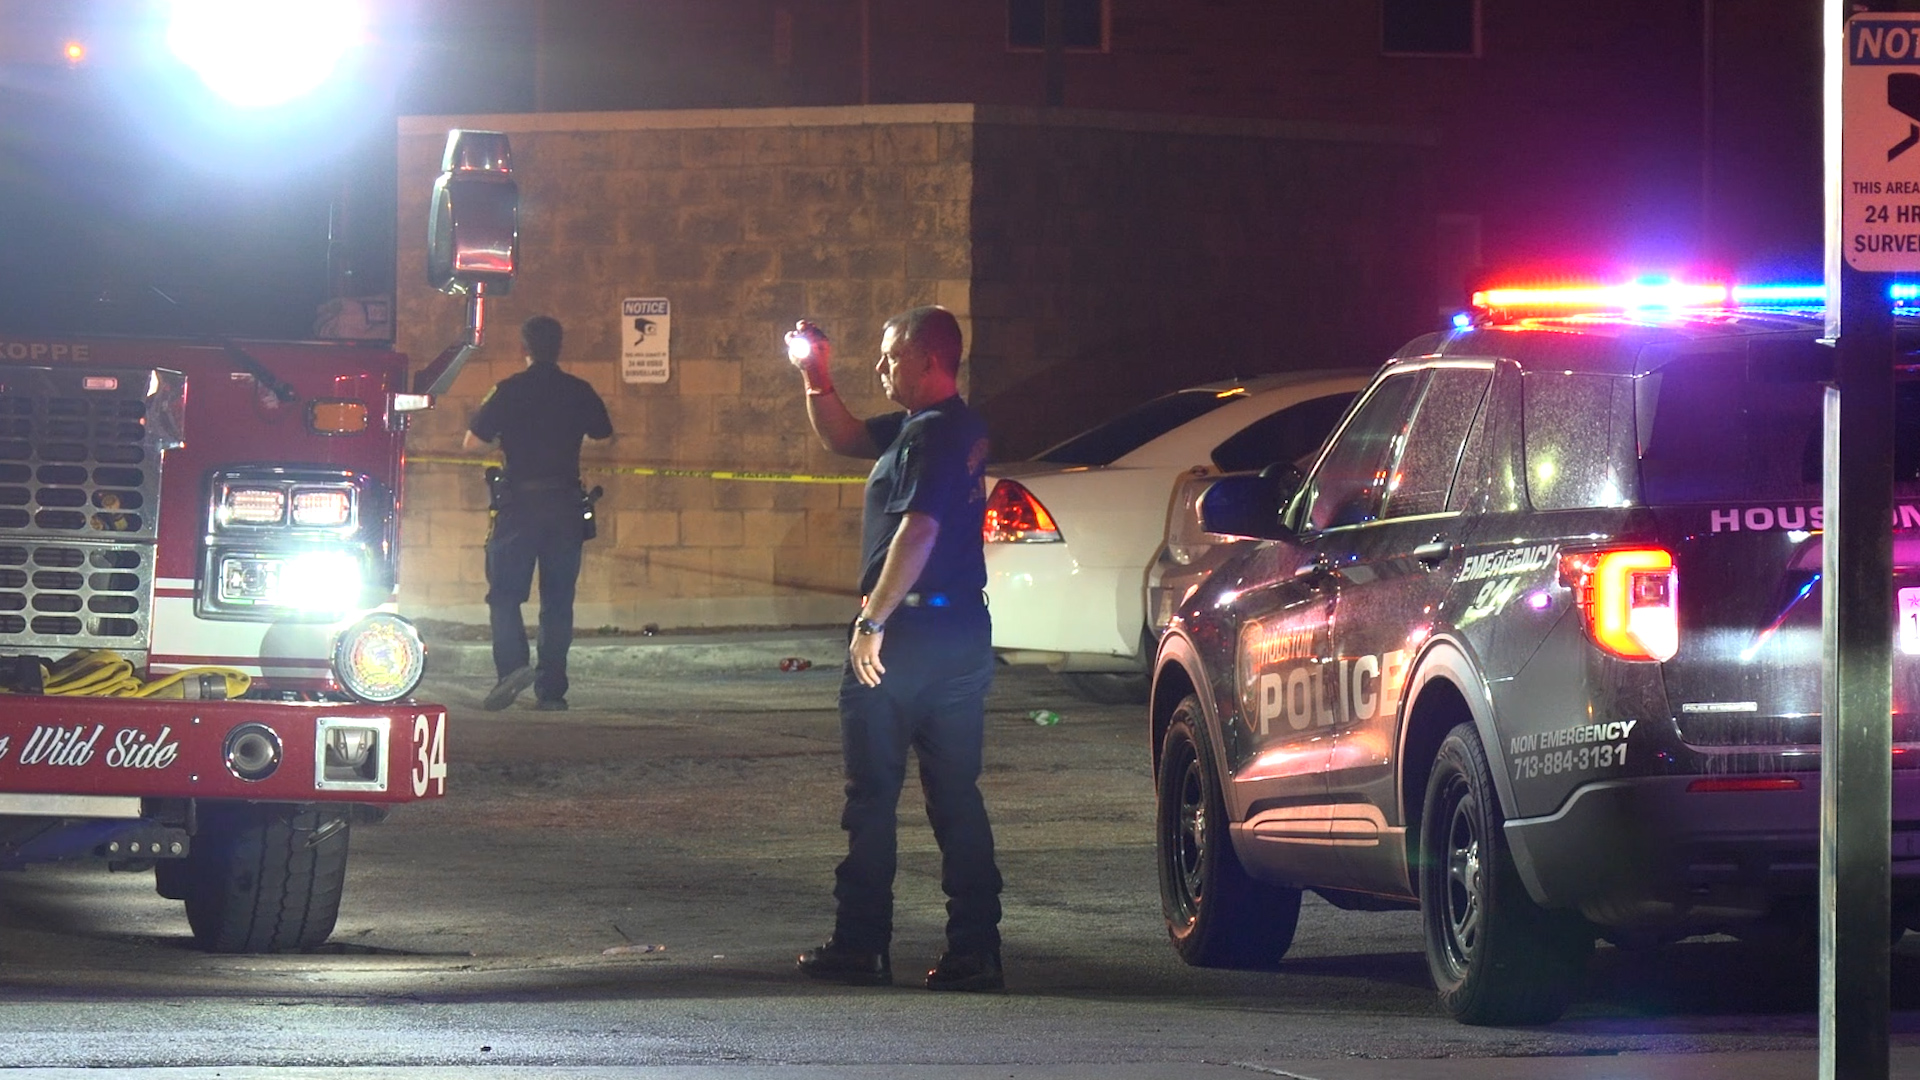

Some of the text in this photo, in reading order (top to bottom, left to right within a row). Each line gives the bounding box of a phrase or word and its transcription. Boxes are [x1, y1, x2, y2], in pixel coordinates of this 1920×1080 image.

[1853, 181, 1920, 194] THIS AREA
[1865, 205, 1920, 223] 24 HR
[625, 302, 666, 314] NOTICE
[0, 342, 89, 361] OPPE
[1711, 505, 1920, 533] HOUN
[1458, 544, 1560, 582] EMERGENCY
[1465, 577, 1521, 617] 911
[1261, 626, 1314, 665] HOUSTON
[1260, 649, 1404, 735] POLICE
[20, 724, 104, 766] Wild
[106, 726, 179, 769] Side
[412, 712, 447, 797] 34
[1511, 720, 1637, 755] NON EMERGENCY
[1514, 743, 1628, 780] 713-884-3131
